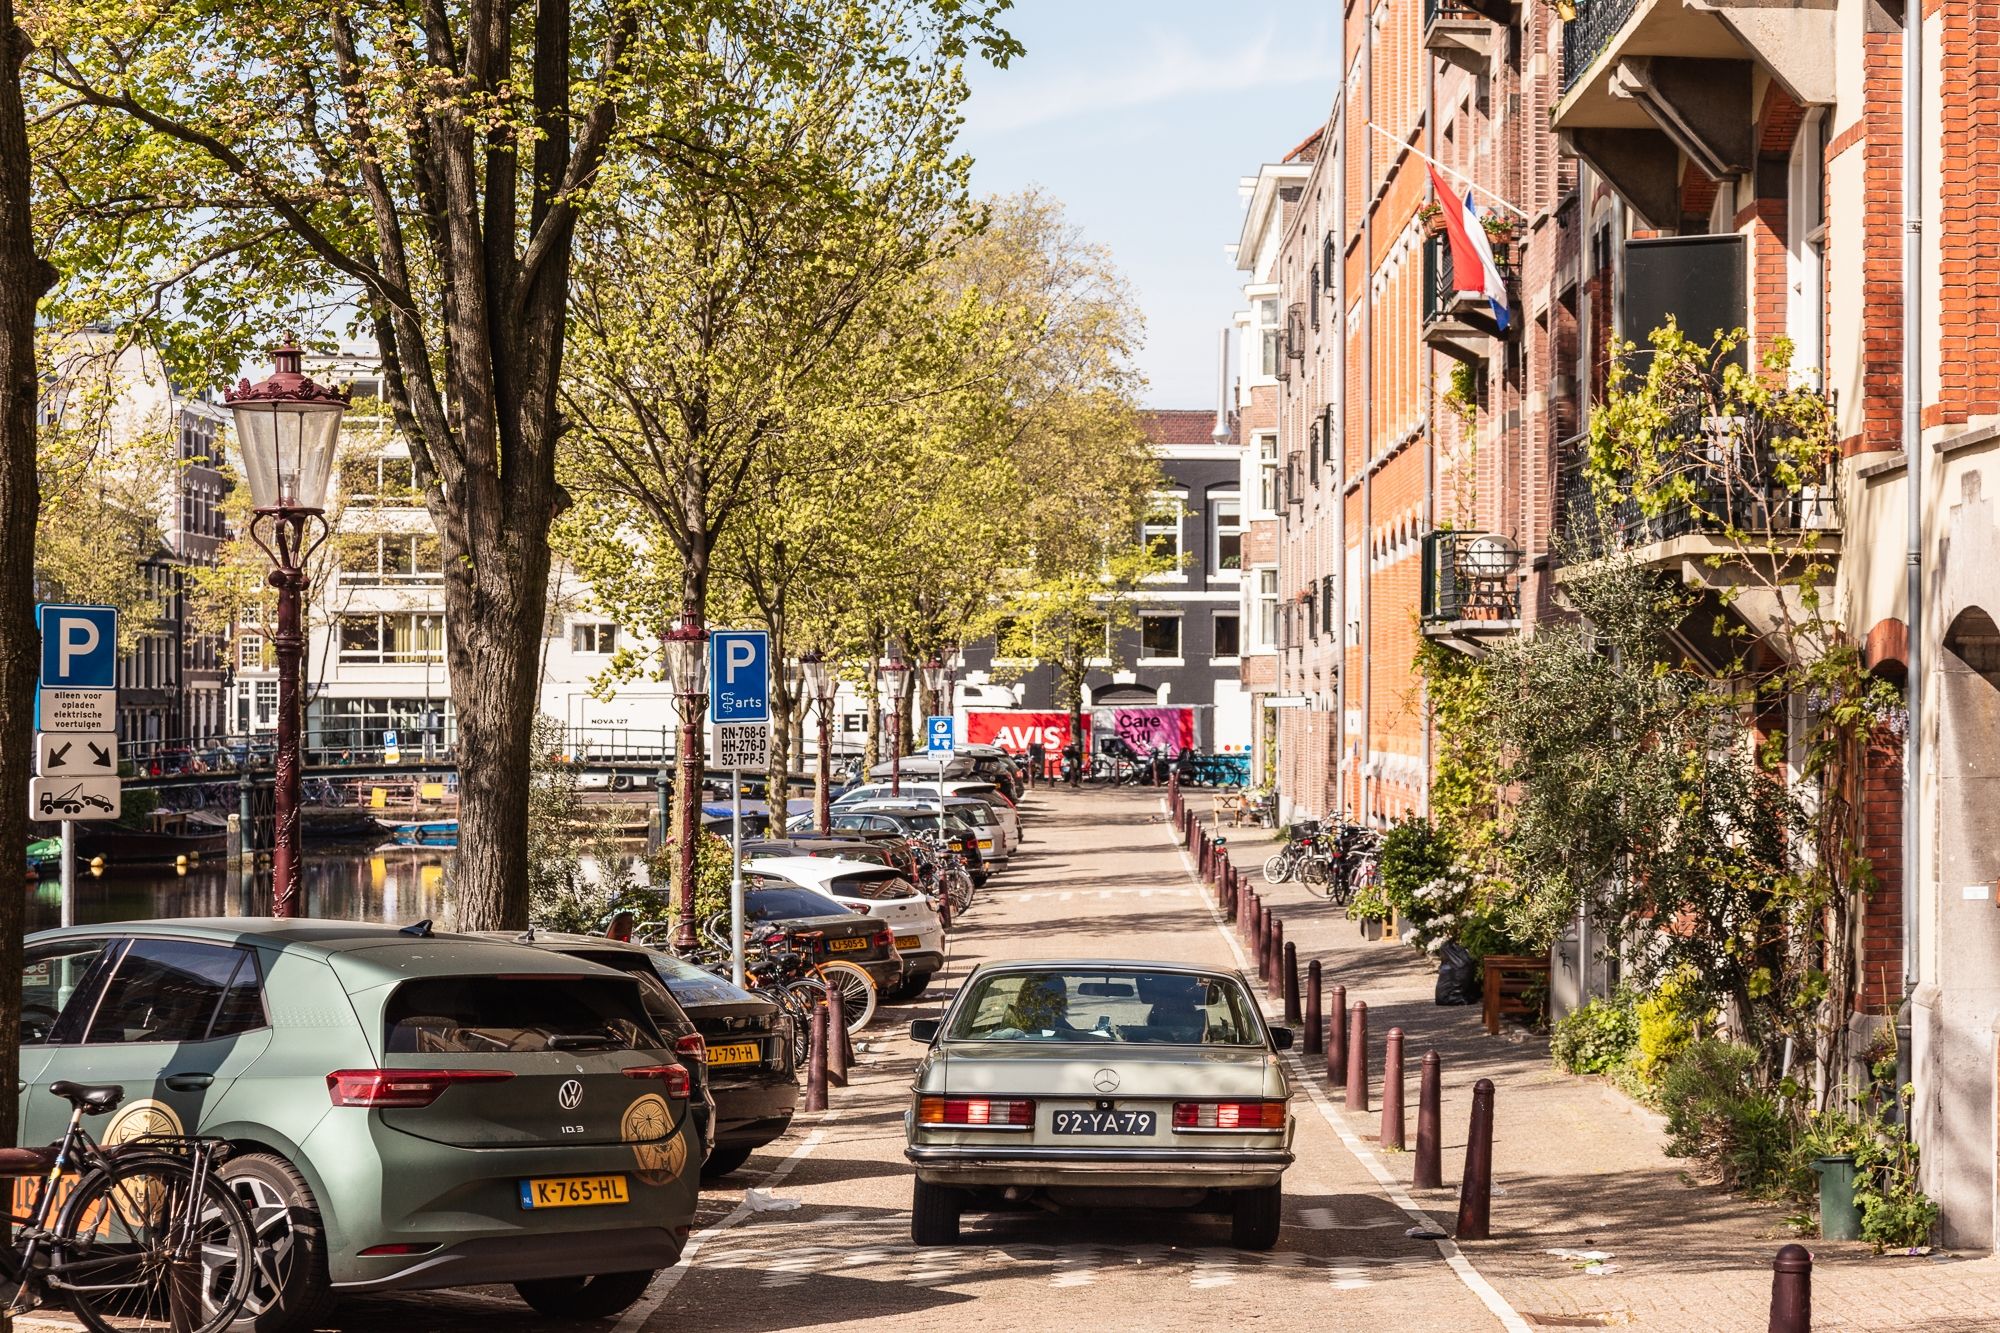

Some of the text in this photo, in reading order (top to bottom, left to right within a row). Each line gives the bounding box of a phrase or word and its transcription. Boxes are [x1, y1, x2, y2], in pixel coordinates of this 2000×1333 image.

[59, 617, 100, 677] P
[726, 639, 756, 684] P
[54, 691, 81, 700] alleen
[61, 701, 95, 711] opladen
[735, 697, 762, 708] arts
[53, 710, 102, 719] elektrische
[55, 720, 102, 729] voertuigen
[1119, 714, 1161, 728] Care
[721, 727, 766, 739] RN-768-G
[994, 726, 1061, 750] AVIS
[721, 740, 766, 752] HH-276-D
[721, 753, 765, 766] 52-TPP-5
[832, 939, 864, 950] KJ-505-S
[1057, 1113, 1150, 1133] 92-YA-79
[537, 1179, 623, 1203] K-765-HL
